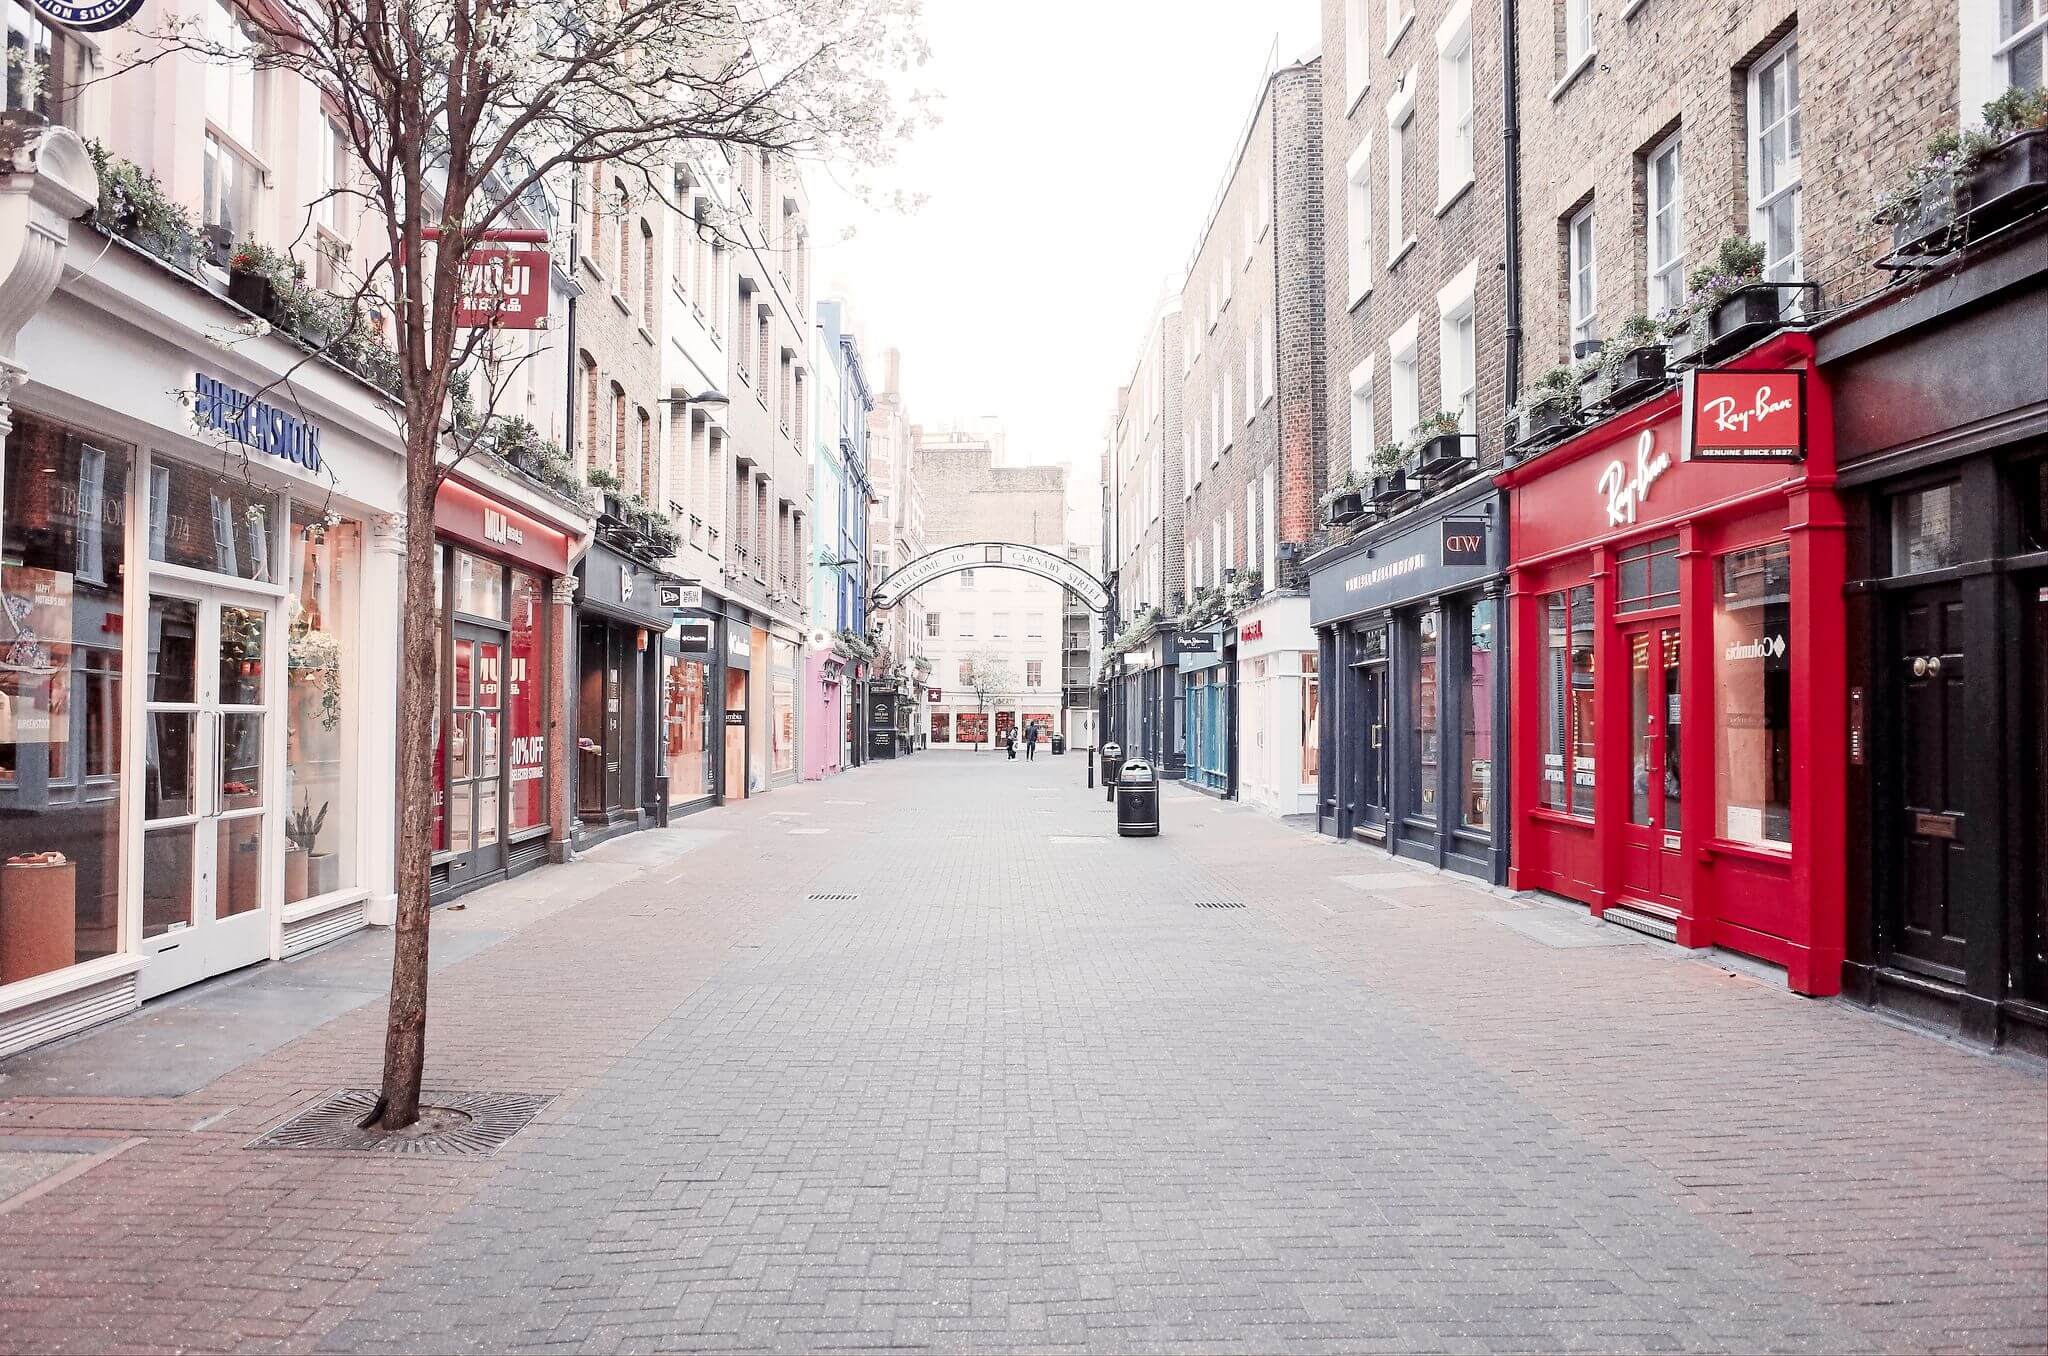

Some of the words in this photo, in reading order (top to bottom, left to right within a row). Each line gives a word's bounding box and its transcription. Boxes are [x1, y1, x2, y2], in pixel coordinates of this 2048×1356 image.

[458, 264, 531, 296] MUJI
[195, 372, 322, 473] BIRKENSTOCK
[1703, 385, 1792, 433] Ray-Ban
[1598, 428, 1672, 528] Ray-Ban
[484, 507, 507, 545] MUJI
[892, 560, 943, 591] WELCOME
[952, 553, 965, 563] TO
[1011, 552, 1062, 574] CARNABY
[1066, 572, 1102, 601] STREET
[511, 736, 529, 765] 10%
[530, 736, 544, 763] OFF
